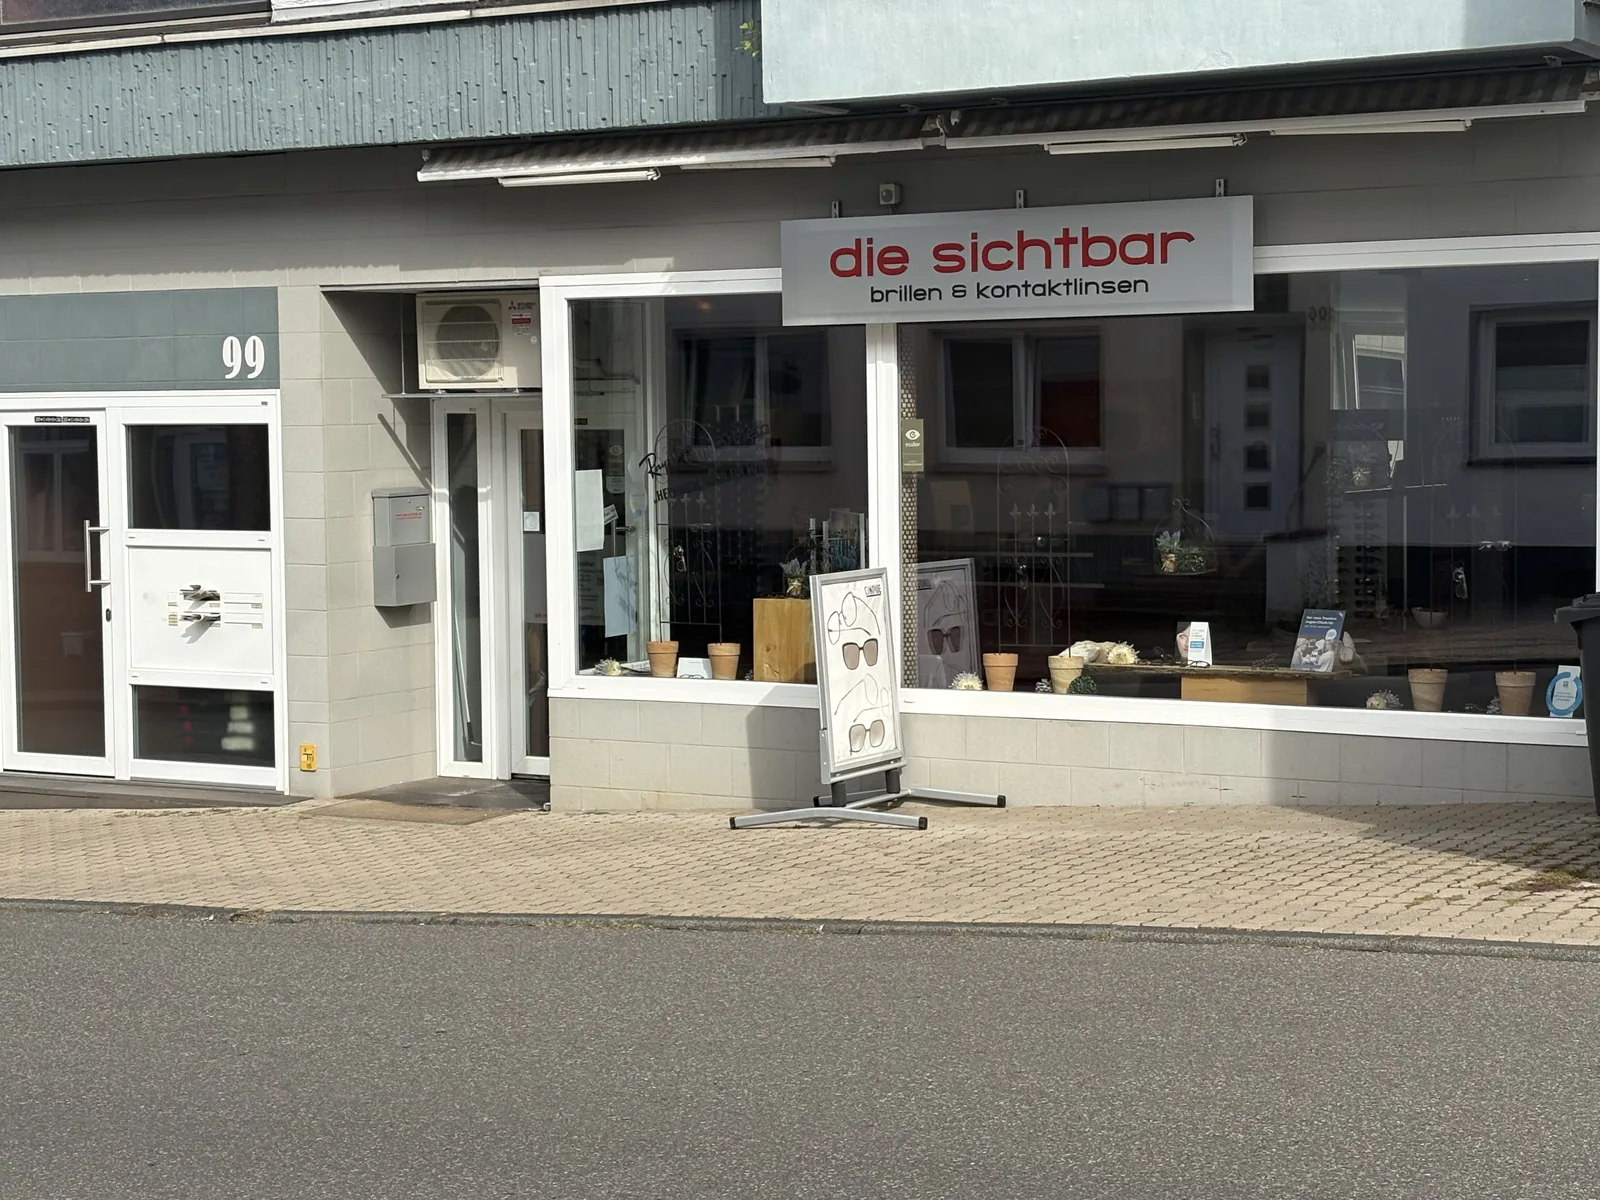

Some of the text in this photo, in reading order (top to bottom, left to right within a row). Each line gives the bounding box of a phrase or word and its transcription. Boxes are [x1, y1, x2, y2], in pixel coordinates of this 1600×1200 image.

[829, 226, 1196, 278] die sichtbar
[870, 278, 1150, 303] brillen & kontaktlinsen
[222, 335, 265, 379] 99
